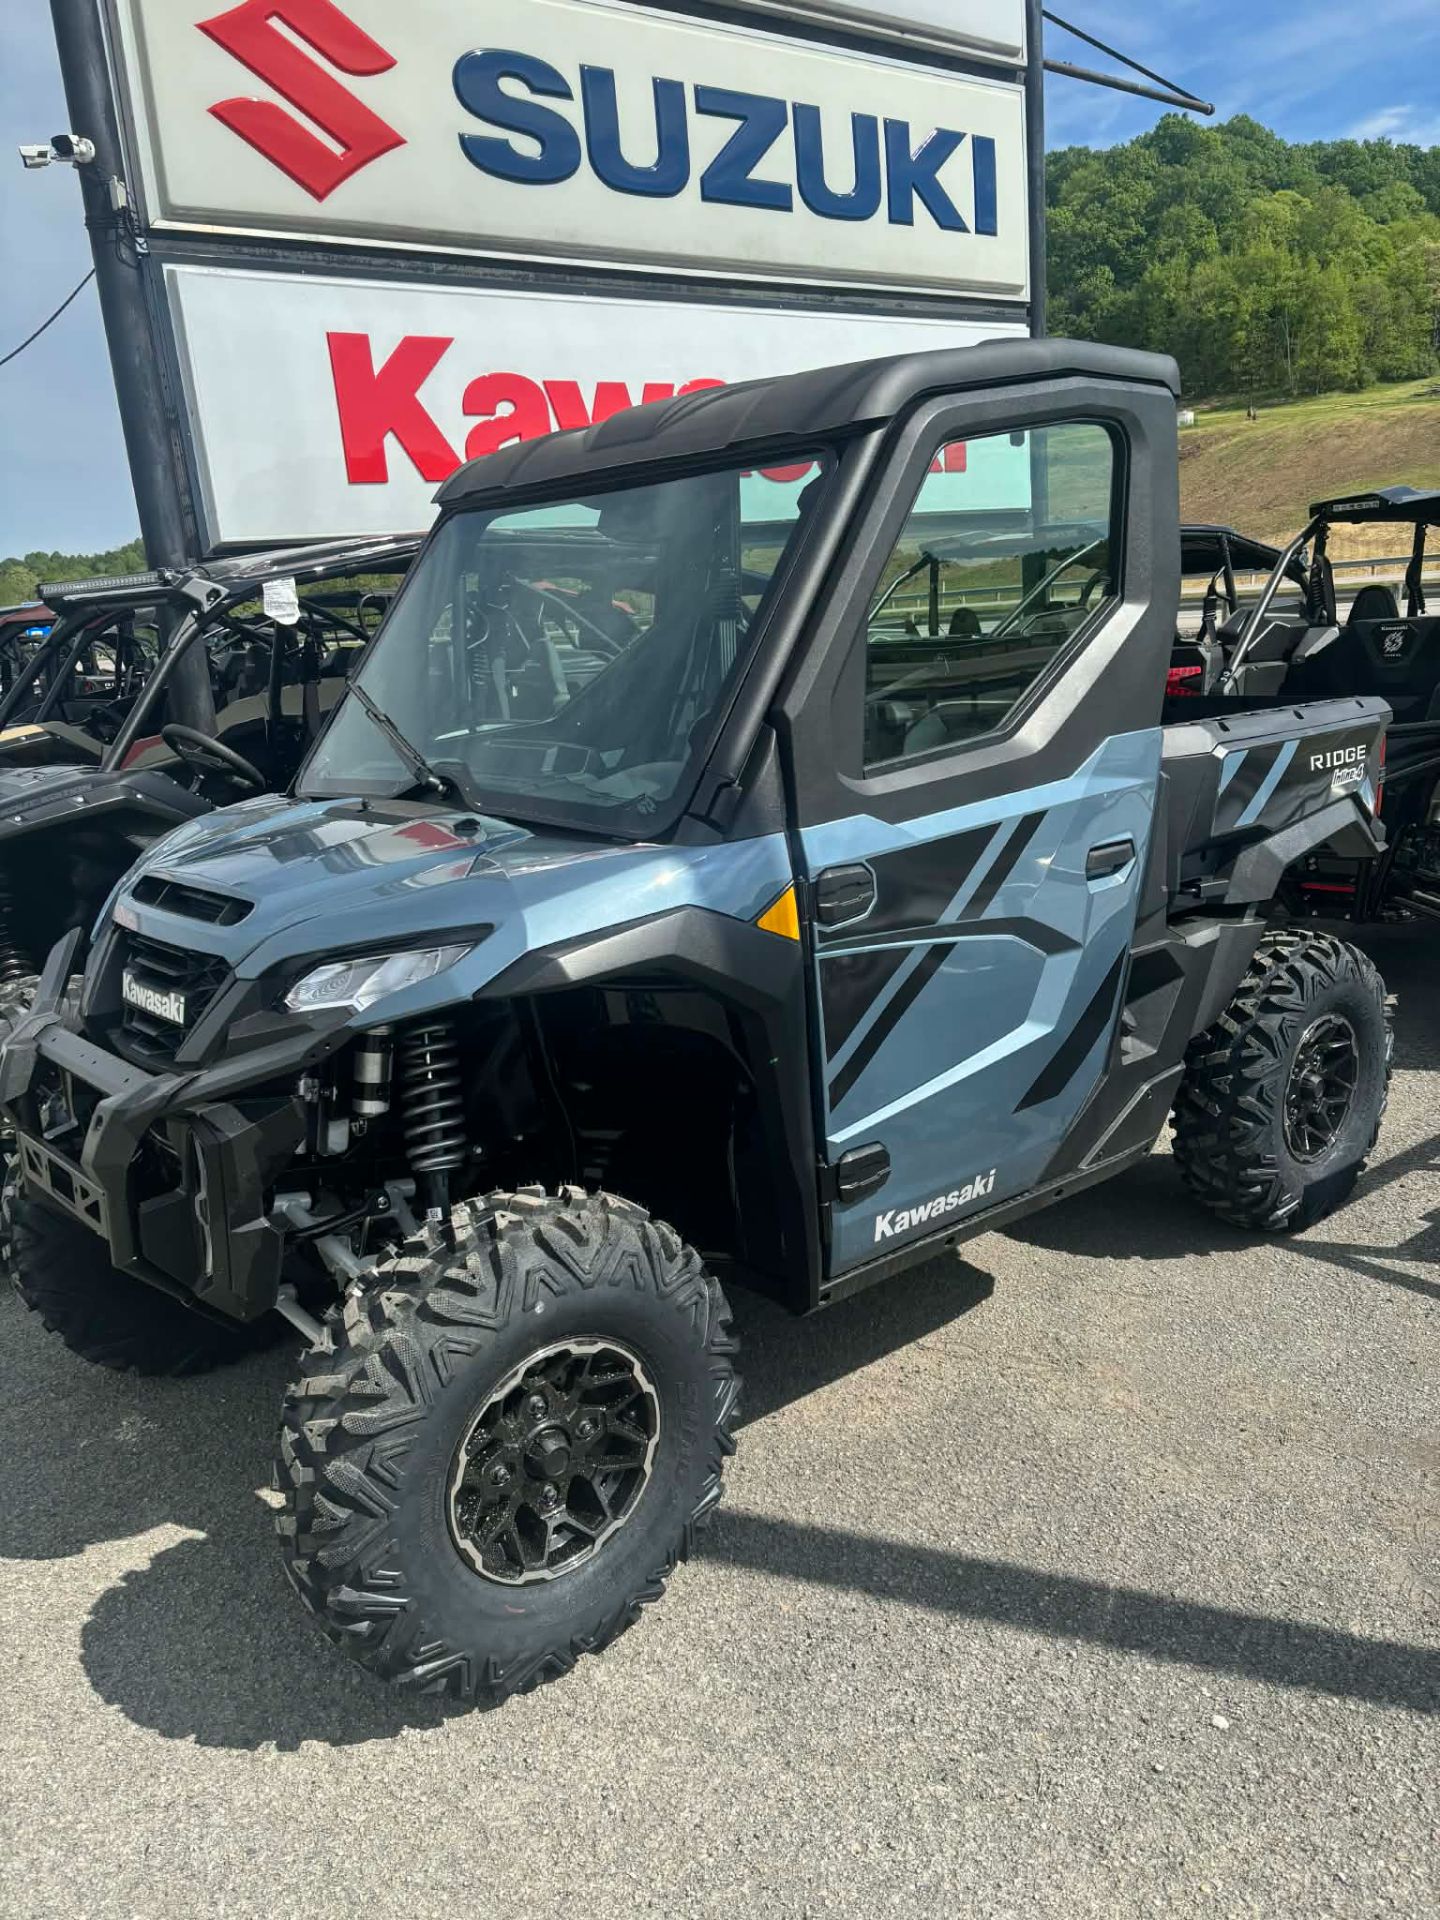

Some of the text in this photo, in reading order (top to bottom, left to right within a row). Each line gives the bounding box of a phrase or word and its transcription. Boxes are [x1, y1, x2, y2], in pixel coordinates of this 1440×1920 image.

[452, 47, 998, 237] SUZUKI
[1310, 744, 1367, 772] RIDGE
[122, 971, 185, 1024] Kawasaki
[874, 1168, 997, 1242] Kawasaki
